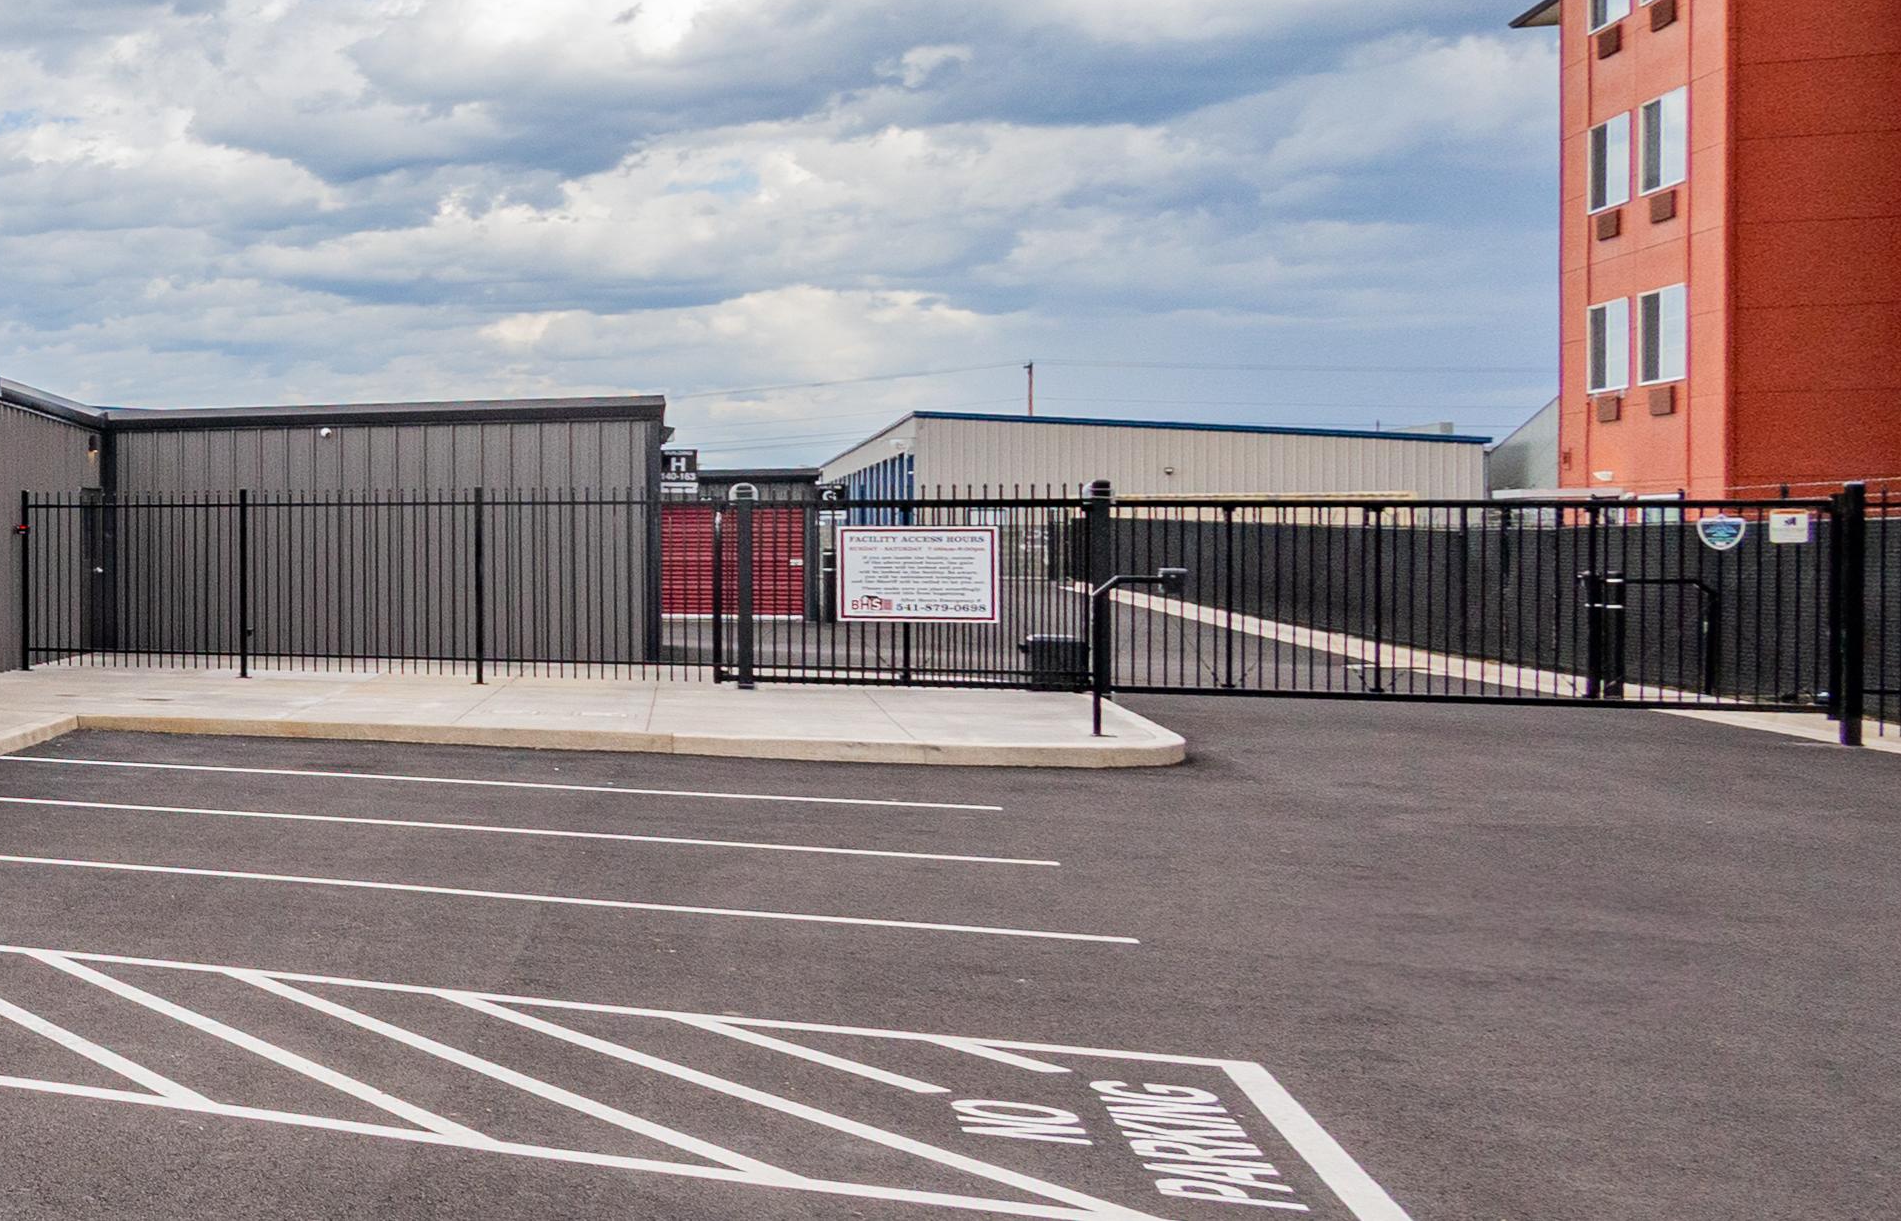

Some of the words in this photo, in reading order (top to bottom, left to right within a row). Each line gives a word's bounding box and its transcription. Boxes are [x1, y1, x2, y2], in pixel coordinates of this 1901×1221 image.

[671, 457, 687, 472] H
[849, 535, 897, 544] FACILITY
[901, 535, 943, 544] ACCESS
[946, 535, 985, 544] HOURS
[851, 596, 883, 611] BHS
[896, 603, 987, 613] 541-879-0698
[950, 1098, 1094, 1146] NO
[1089, 1079, 1310, 1212] PARKING
